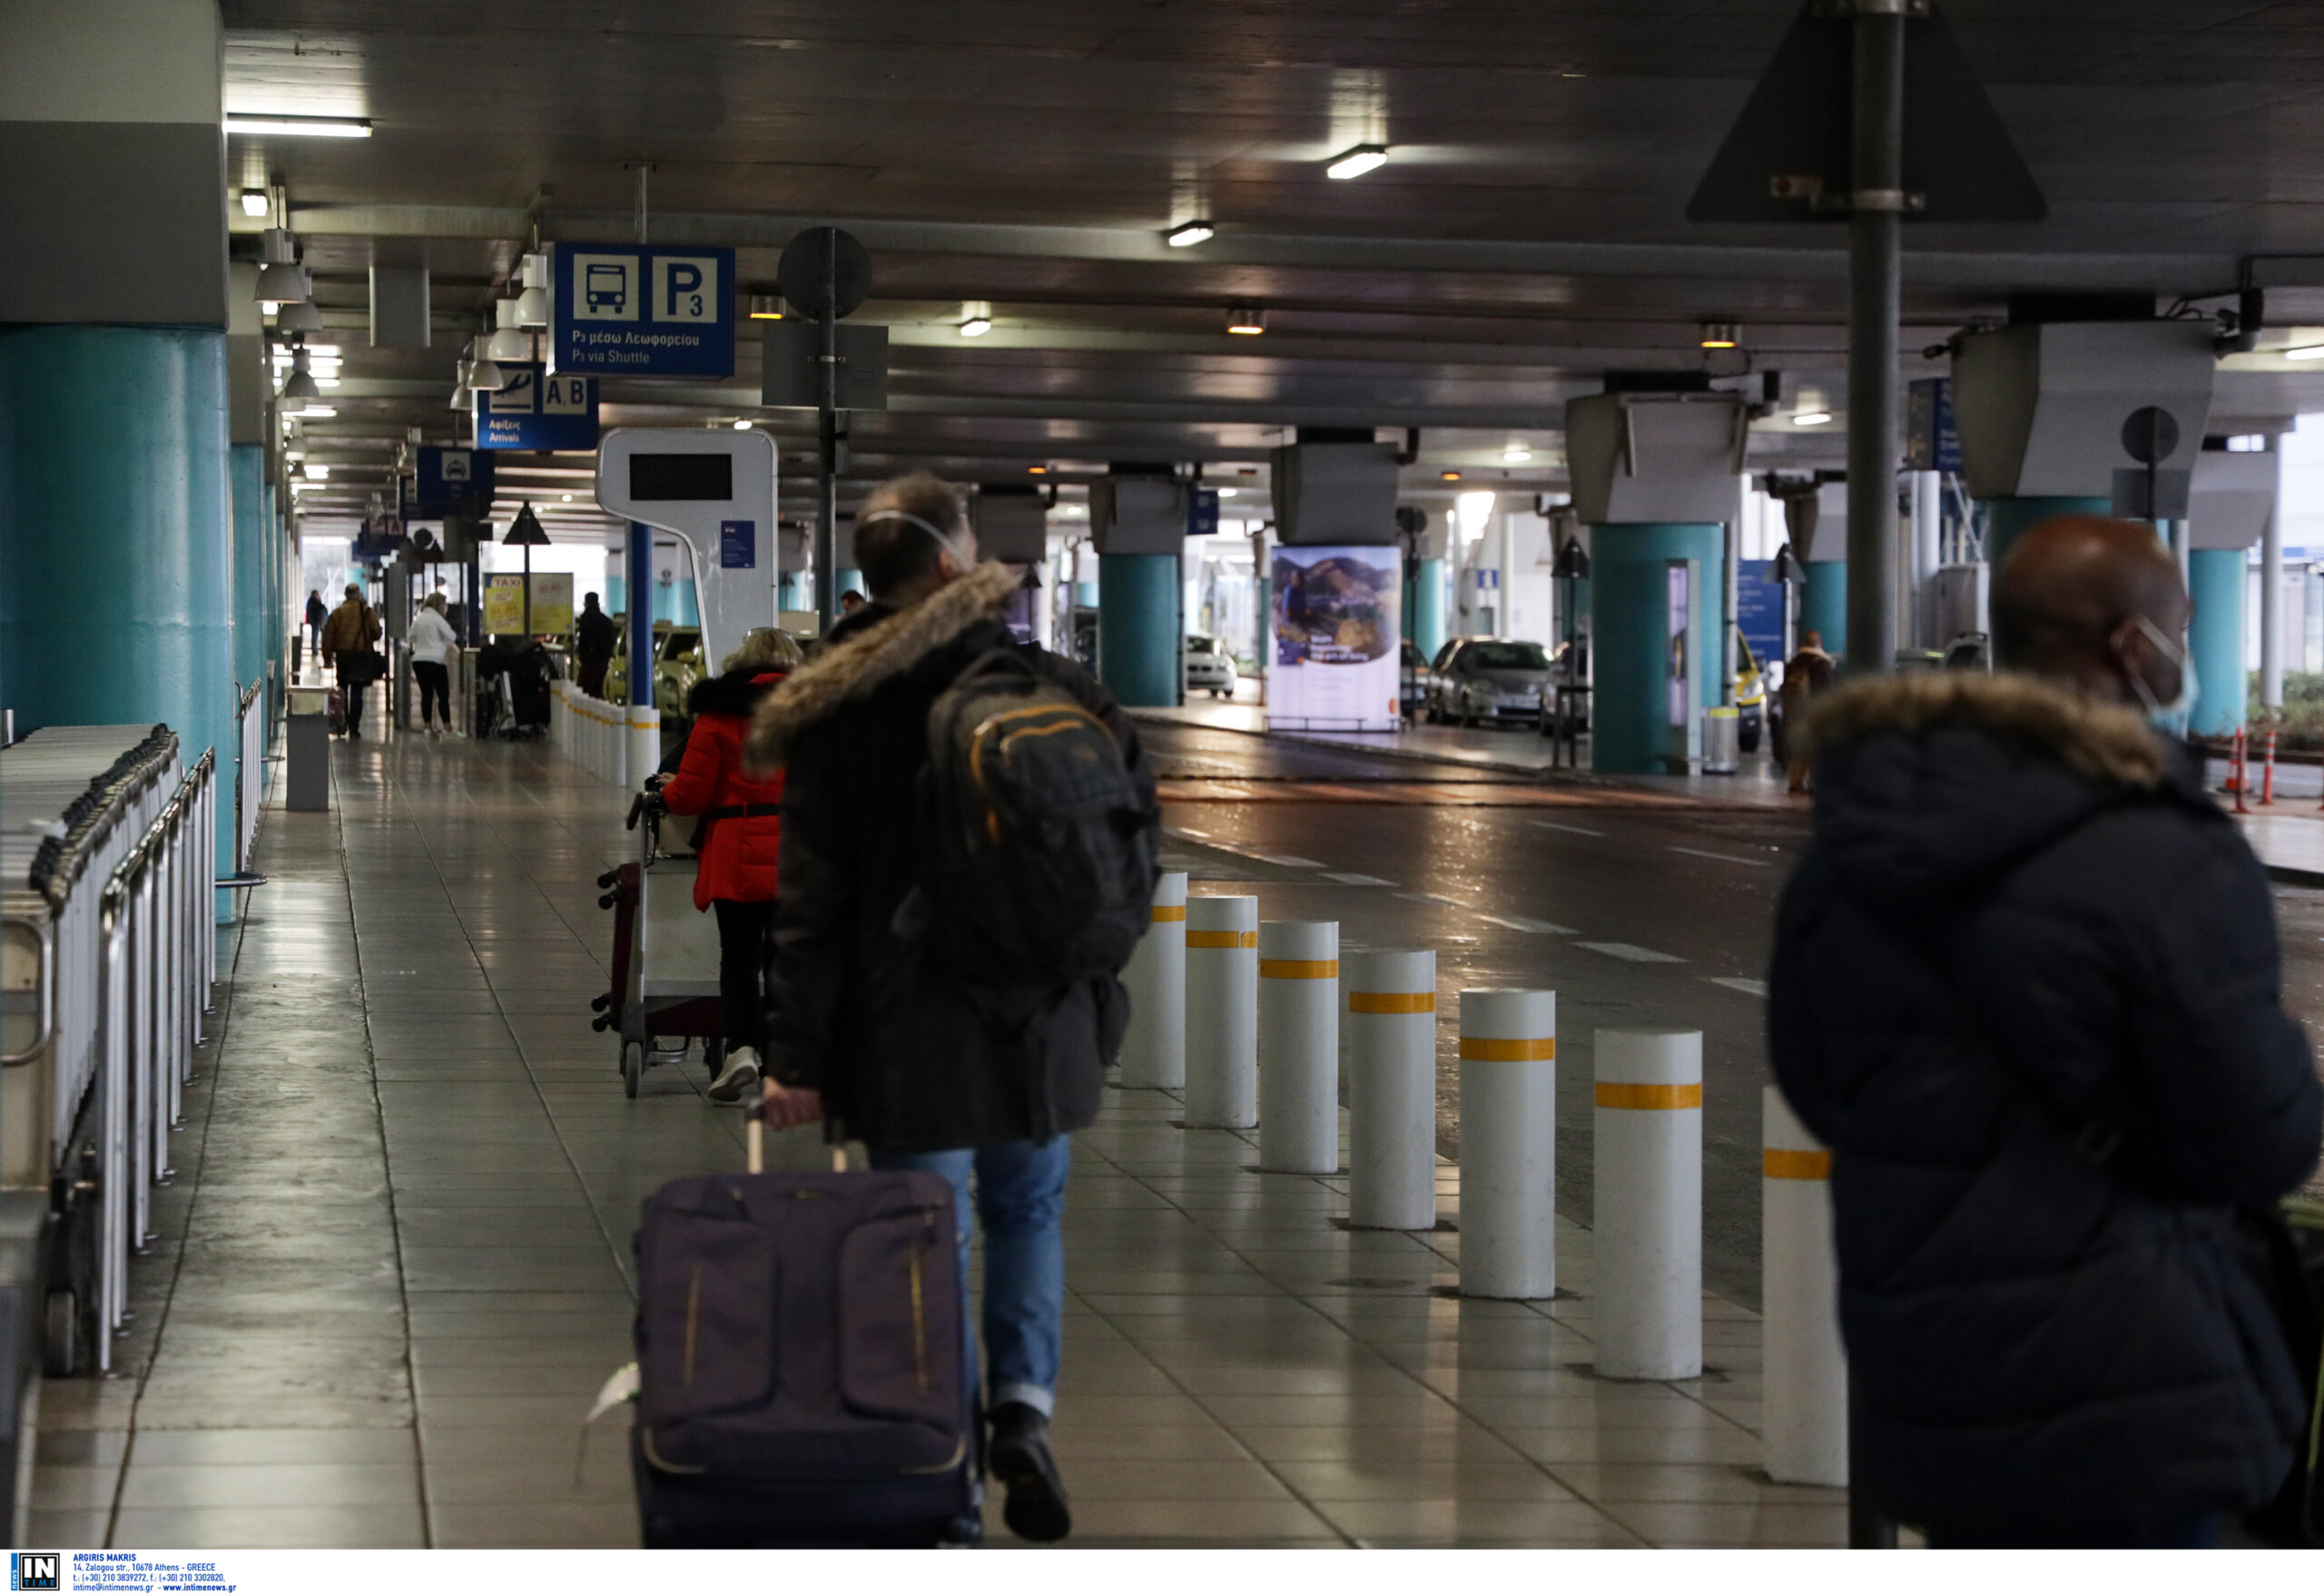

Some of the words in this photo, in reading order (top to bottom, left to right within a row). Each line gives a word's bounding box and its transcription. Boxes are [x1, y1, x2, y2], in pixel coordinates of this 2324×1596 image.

[589, 331, 622, 345] μέσω
[625, 331, 700, 347] Λεωφορείου
[588, 350, 606, 362] via
[607, 350, 650, 363] Shuttle
[488, 432, 520, 442] Arrivals
[494, 578, 521, 587] TAXI
